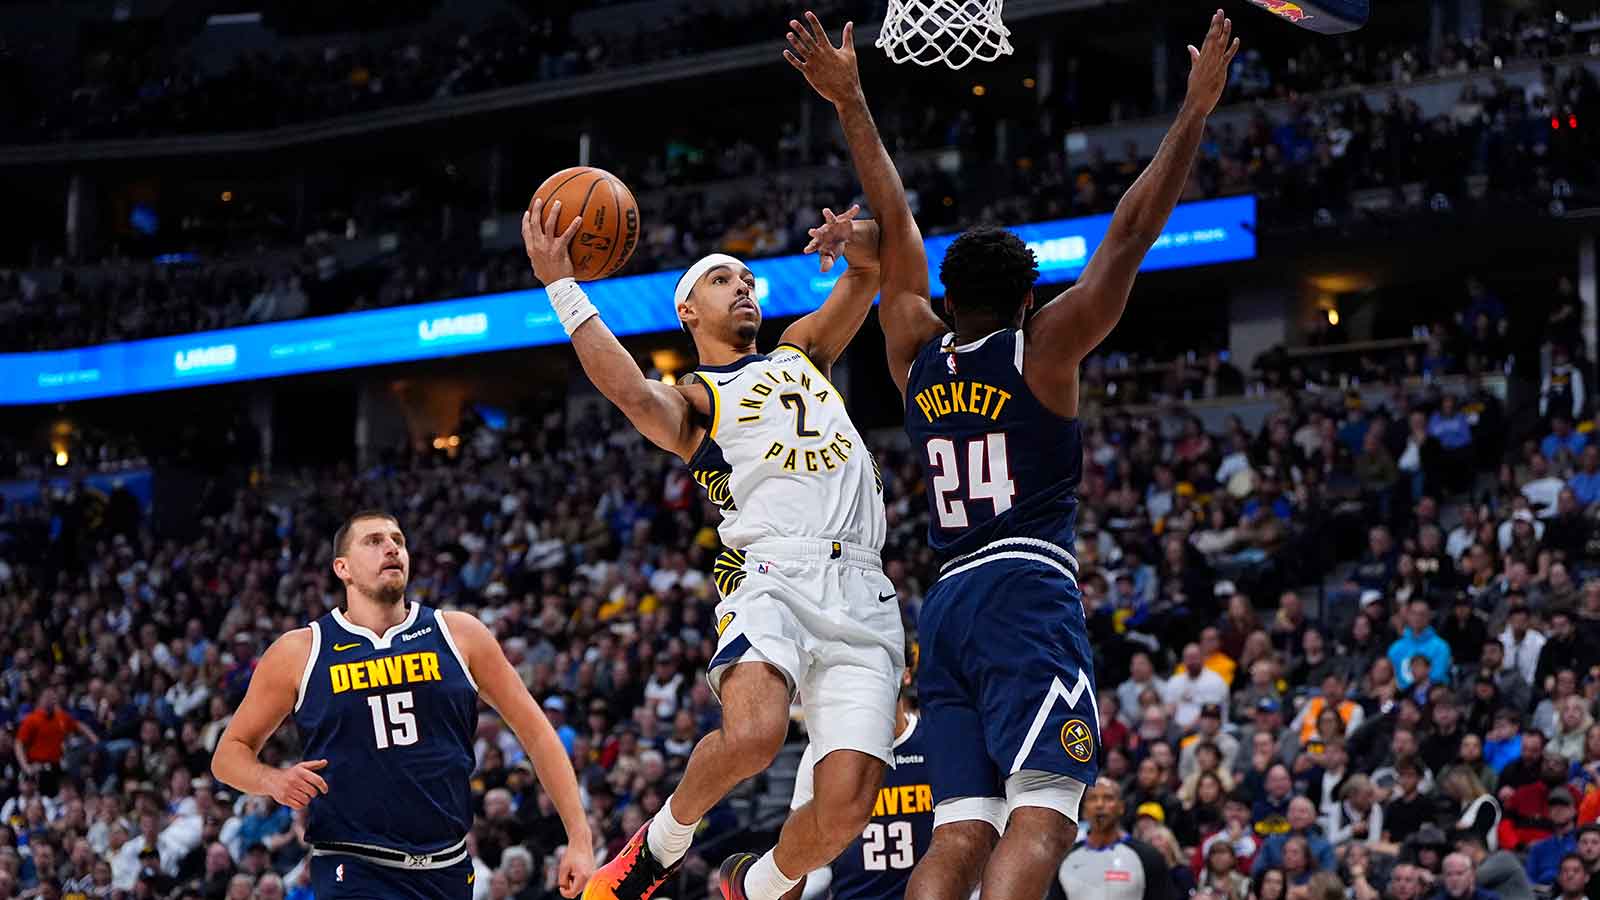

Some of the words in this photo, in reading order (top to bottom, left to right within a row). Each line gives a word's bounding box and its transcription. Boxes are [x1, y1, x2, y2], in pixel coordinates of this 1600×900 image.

[738, 371, 829, 422] INDIANA
[779, 392, 821, 438] 2
[914, 381, 1012, 423] PICKETT
[764, 432, 853, 472] PACERS
[926, 432, 1016, 529] 24
[329, 651, 442, 695] DENVER
[367, 691, 419, 750] 15
[862, 820, 915, 871] 23
